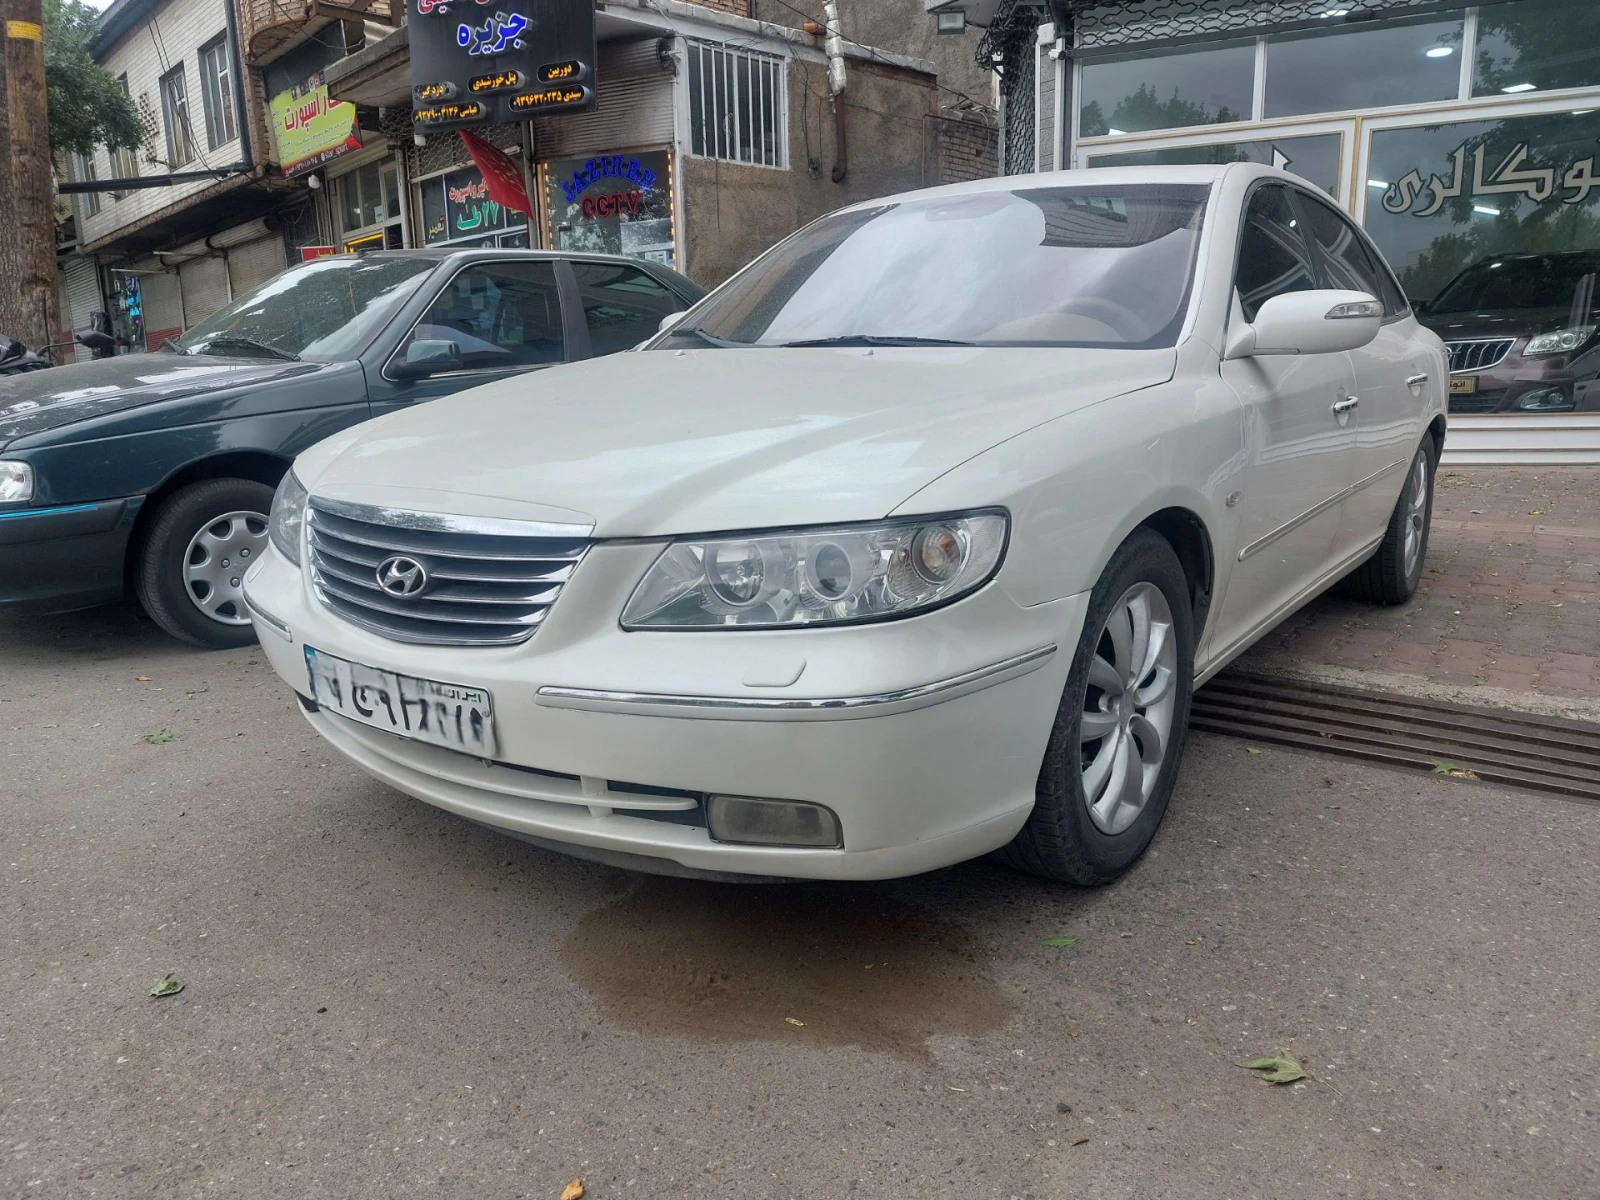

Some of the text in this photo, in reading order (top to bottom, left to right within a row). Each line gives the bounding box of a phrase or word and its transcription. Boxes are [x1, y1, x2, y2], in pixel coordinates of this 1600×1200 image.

[457, 11, 528, 55] جزیره
[472, 71, 517, 91] پنل خورشیدی
[548, 64, 573, 79] دوربین
[284, 92, 321, 132] اسپورت
[562, 155, 657, 203] JAZIREH
[581, 189, 642, 219] CCTV
